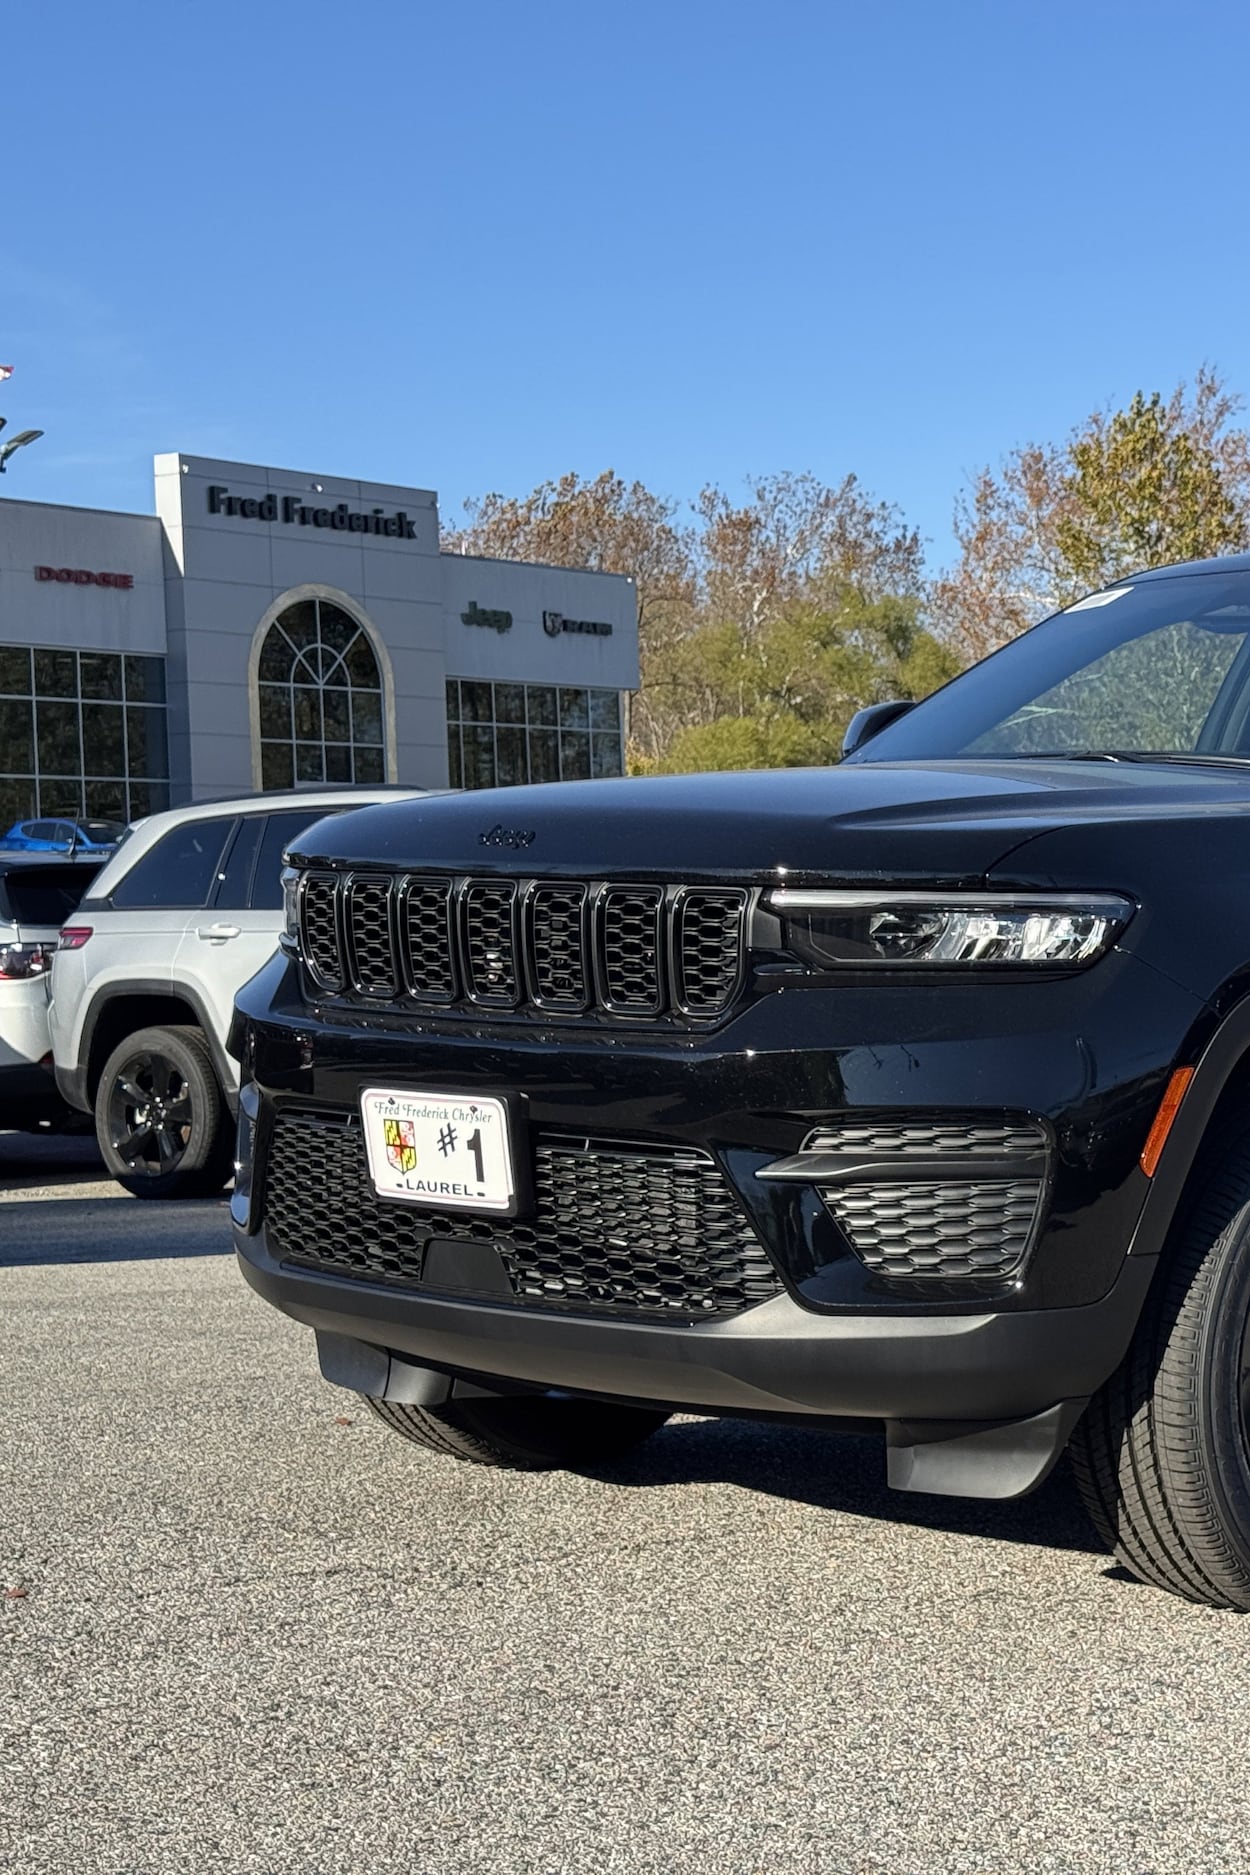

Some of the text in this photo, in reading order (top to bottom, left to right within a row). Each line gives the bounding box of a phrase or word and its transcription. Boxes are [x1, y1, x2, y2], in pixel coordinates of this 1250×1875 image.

[207, 485, 418, 540] Fred Frederick
[34, 566, 134, 590] DODGE
[461, 601, 513, 635] Jeep
[374, 1101, 493, 1124] Fred Frederick Chrysler
[405, 1178, 474, 1197] LAUREL
